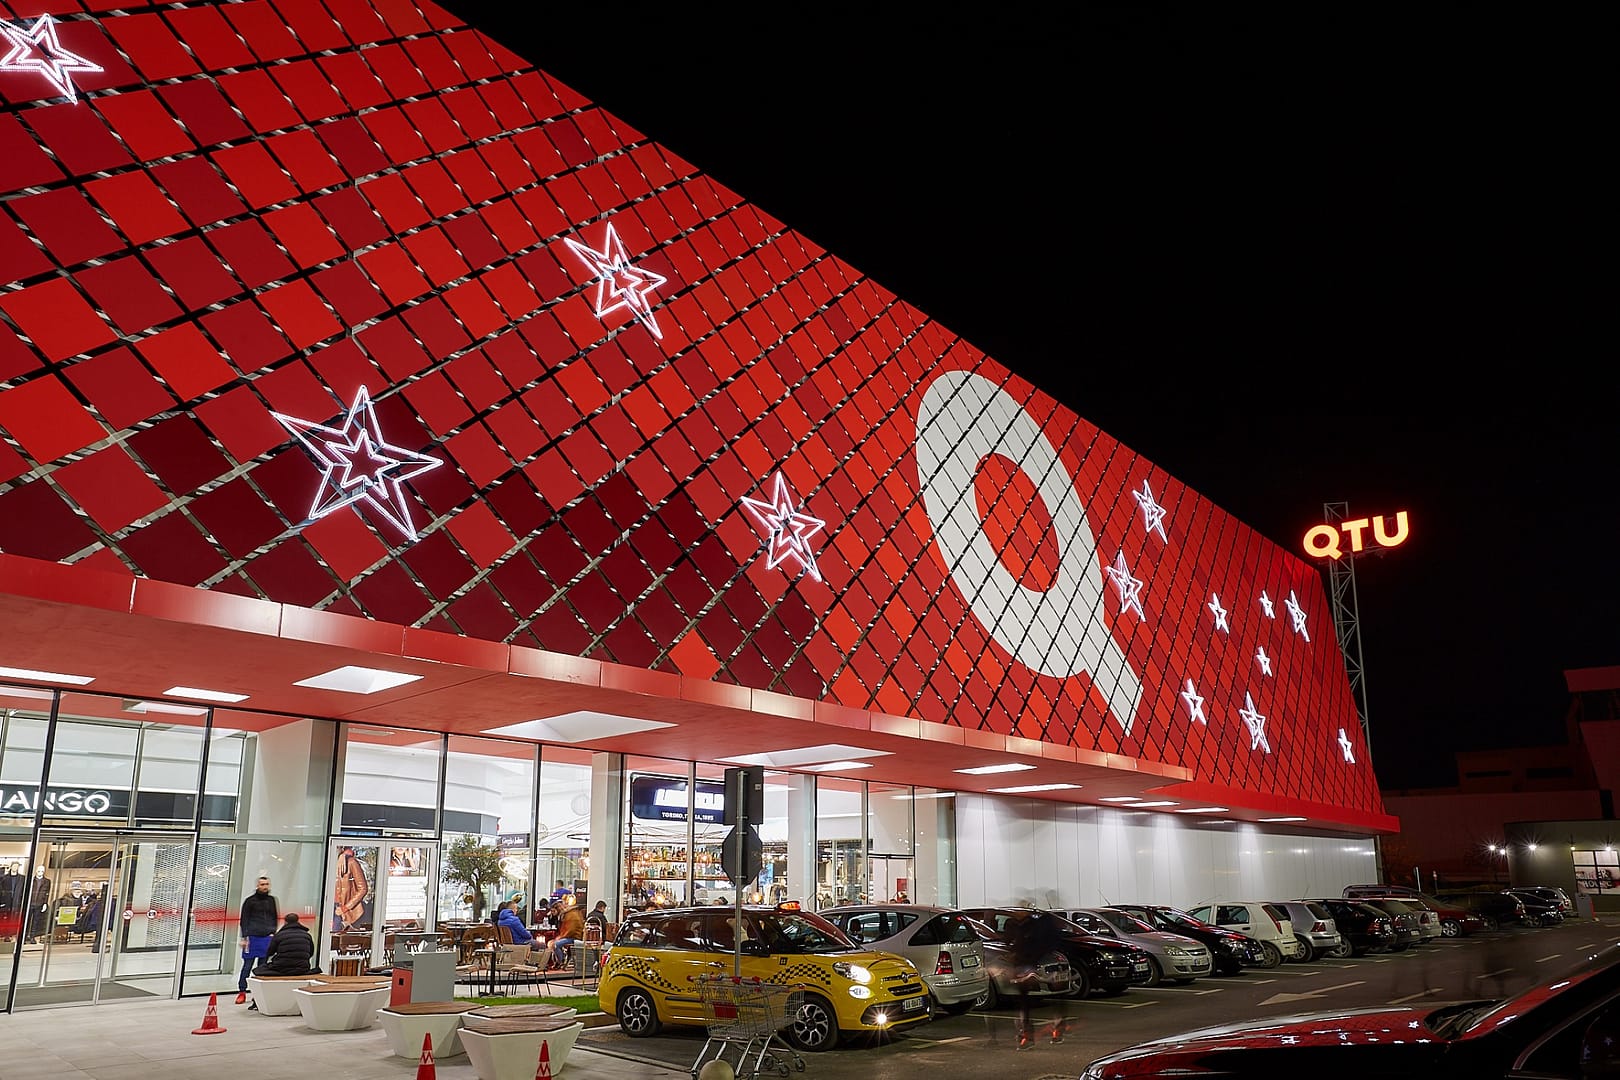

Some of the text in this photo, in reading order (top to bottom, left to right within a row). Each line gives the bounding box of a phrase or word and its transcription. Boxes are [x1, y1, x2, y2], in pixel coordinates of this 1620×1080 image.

[915, 370, 1144, 737] Q
[1303, 511, 1409, 560] QTU
[0, 789, 110, 814] ANGO
